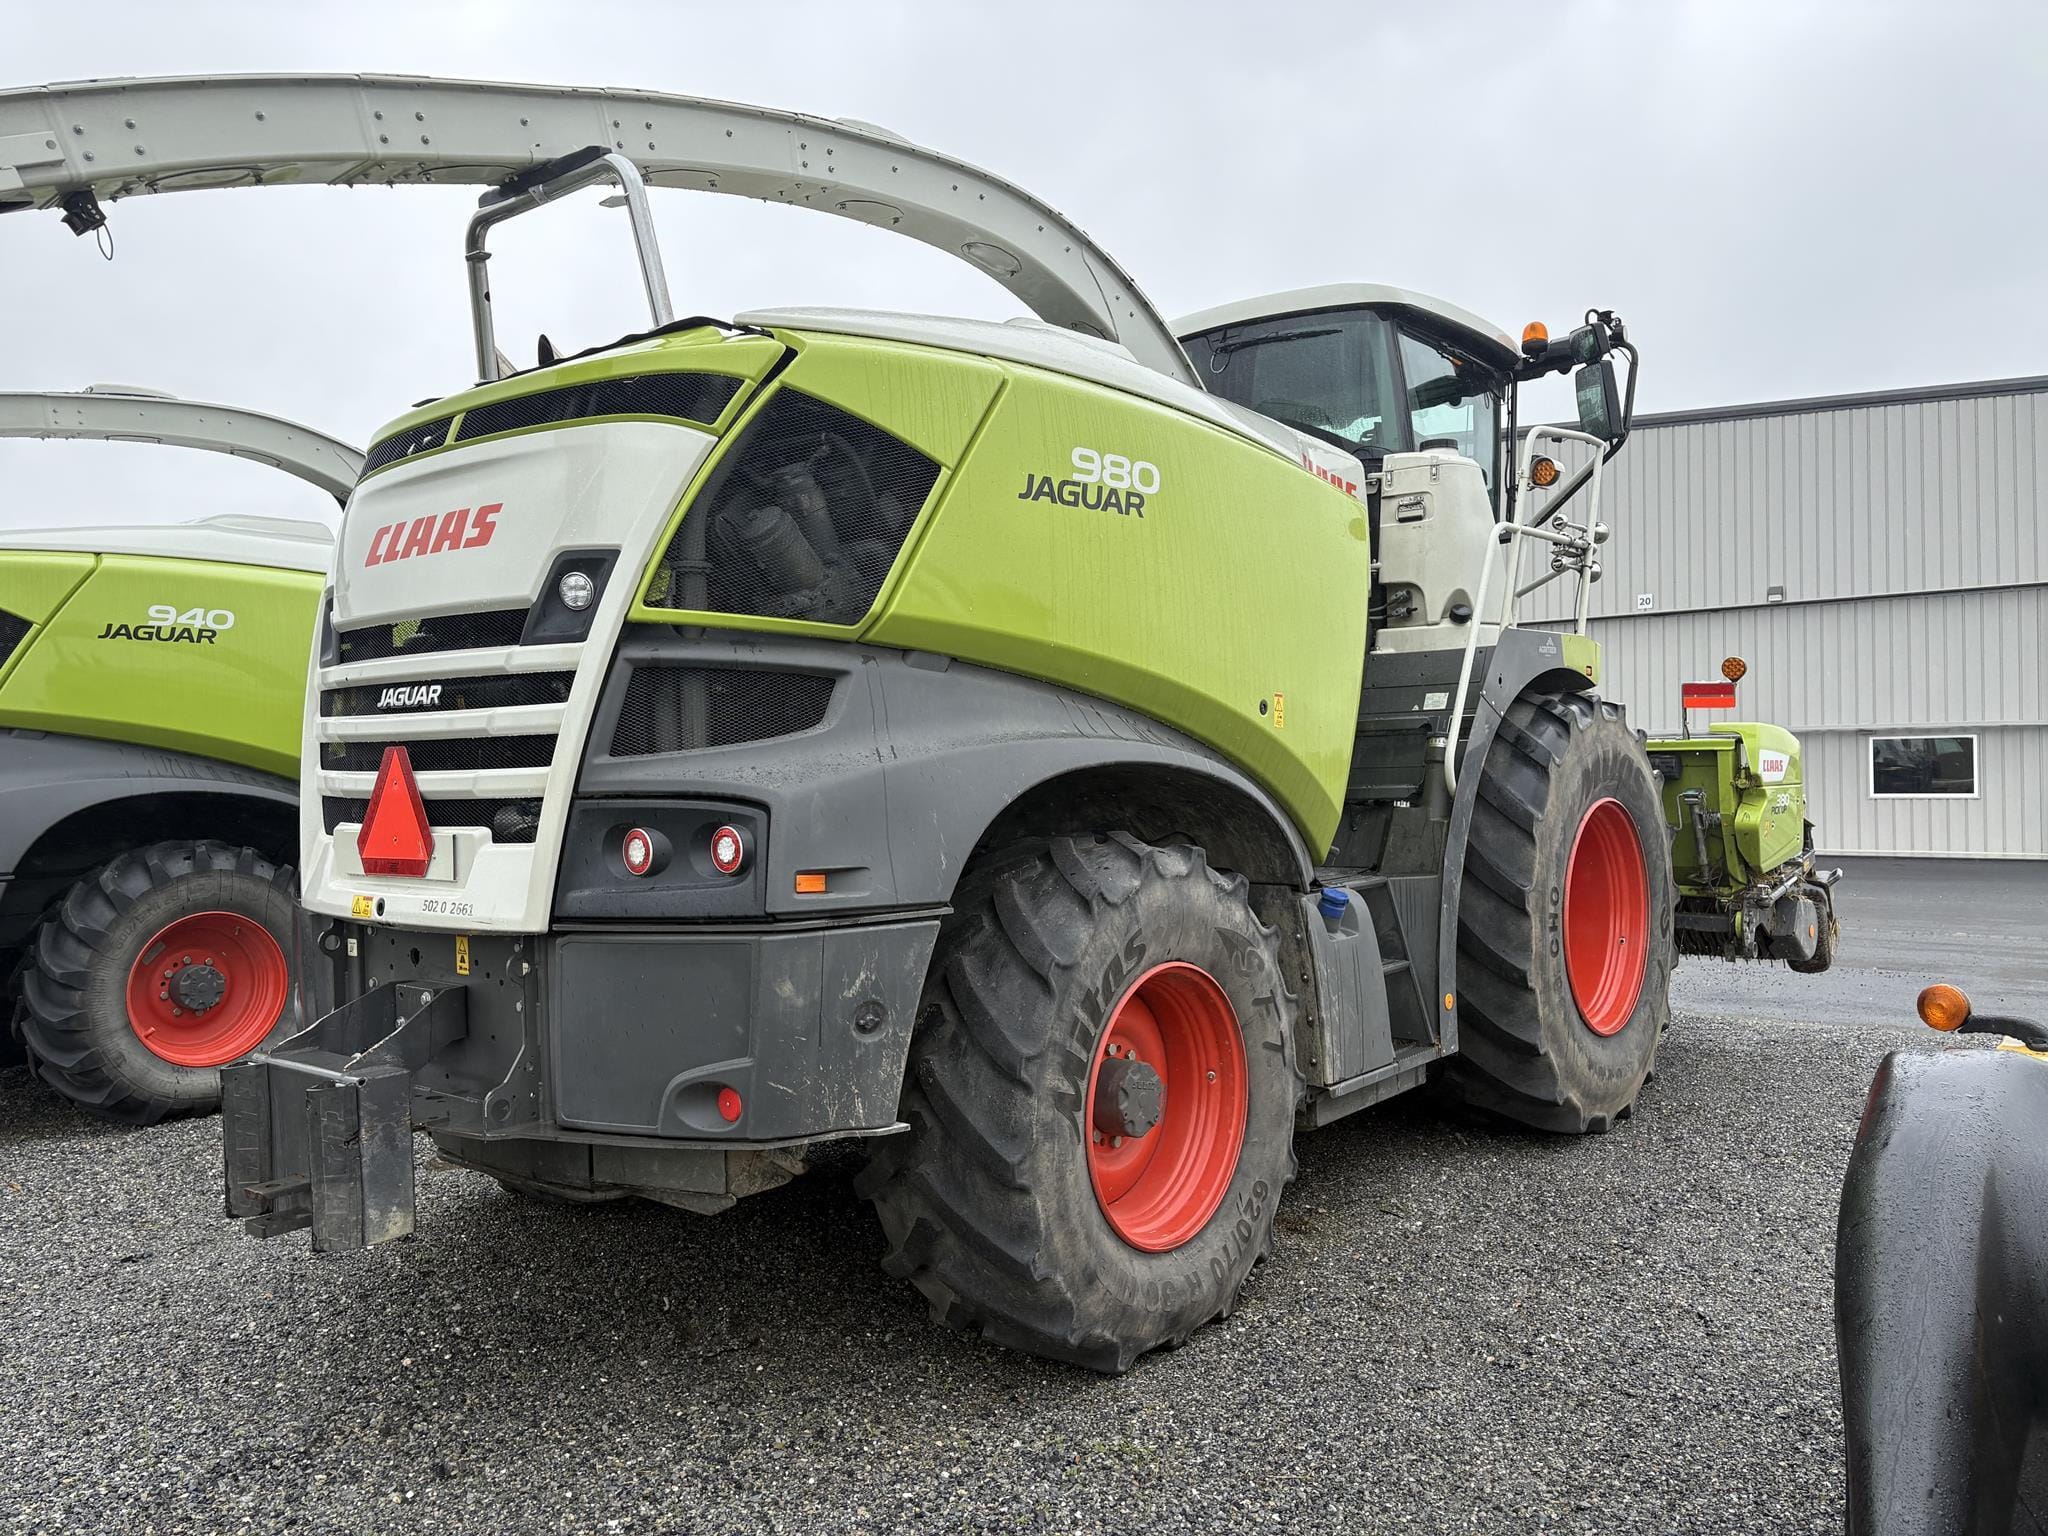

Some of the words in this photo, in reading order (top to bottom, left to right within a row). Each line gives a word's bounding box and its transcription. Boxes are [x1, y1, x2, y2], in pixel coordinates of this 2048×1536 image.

[1072, 446, 1160, 495] 980
[1018, 473, 1145, 518] JAGUAR
[365, 502, 504, 567] CLAAS
[1639, 597, 1651, 606] 20
[148, 605, 235, 630] 940
[97, 623, 217, 644] JAGUAR
[377, 684, 442, 708] JAGUAR
[1763, 759, 1783, 772] CLAAS
[422, 899, 439, 912] 502
[440, 901, 447, 914] 0
[1210, 1179, 1269, 1286] 620/70
